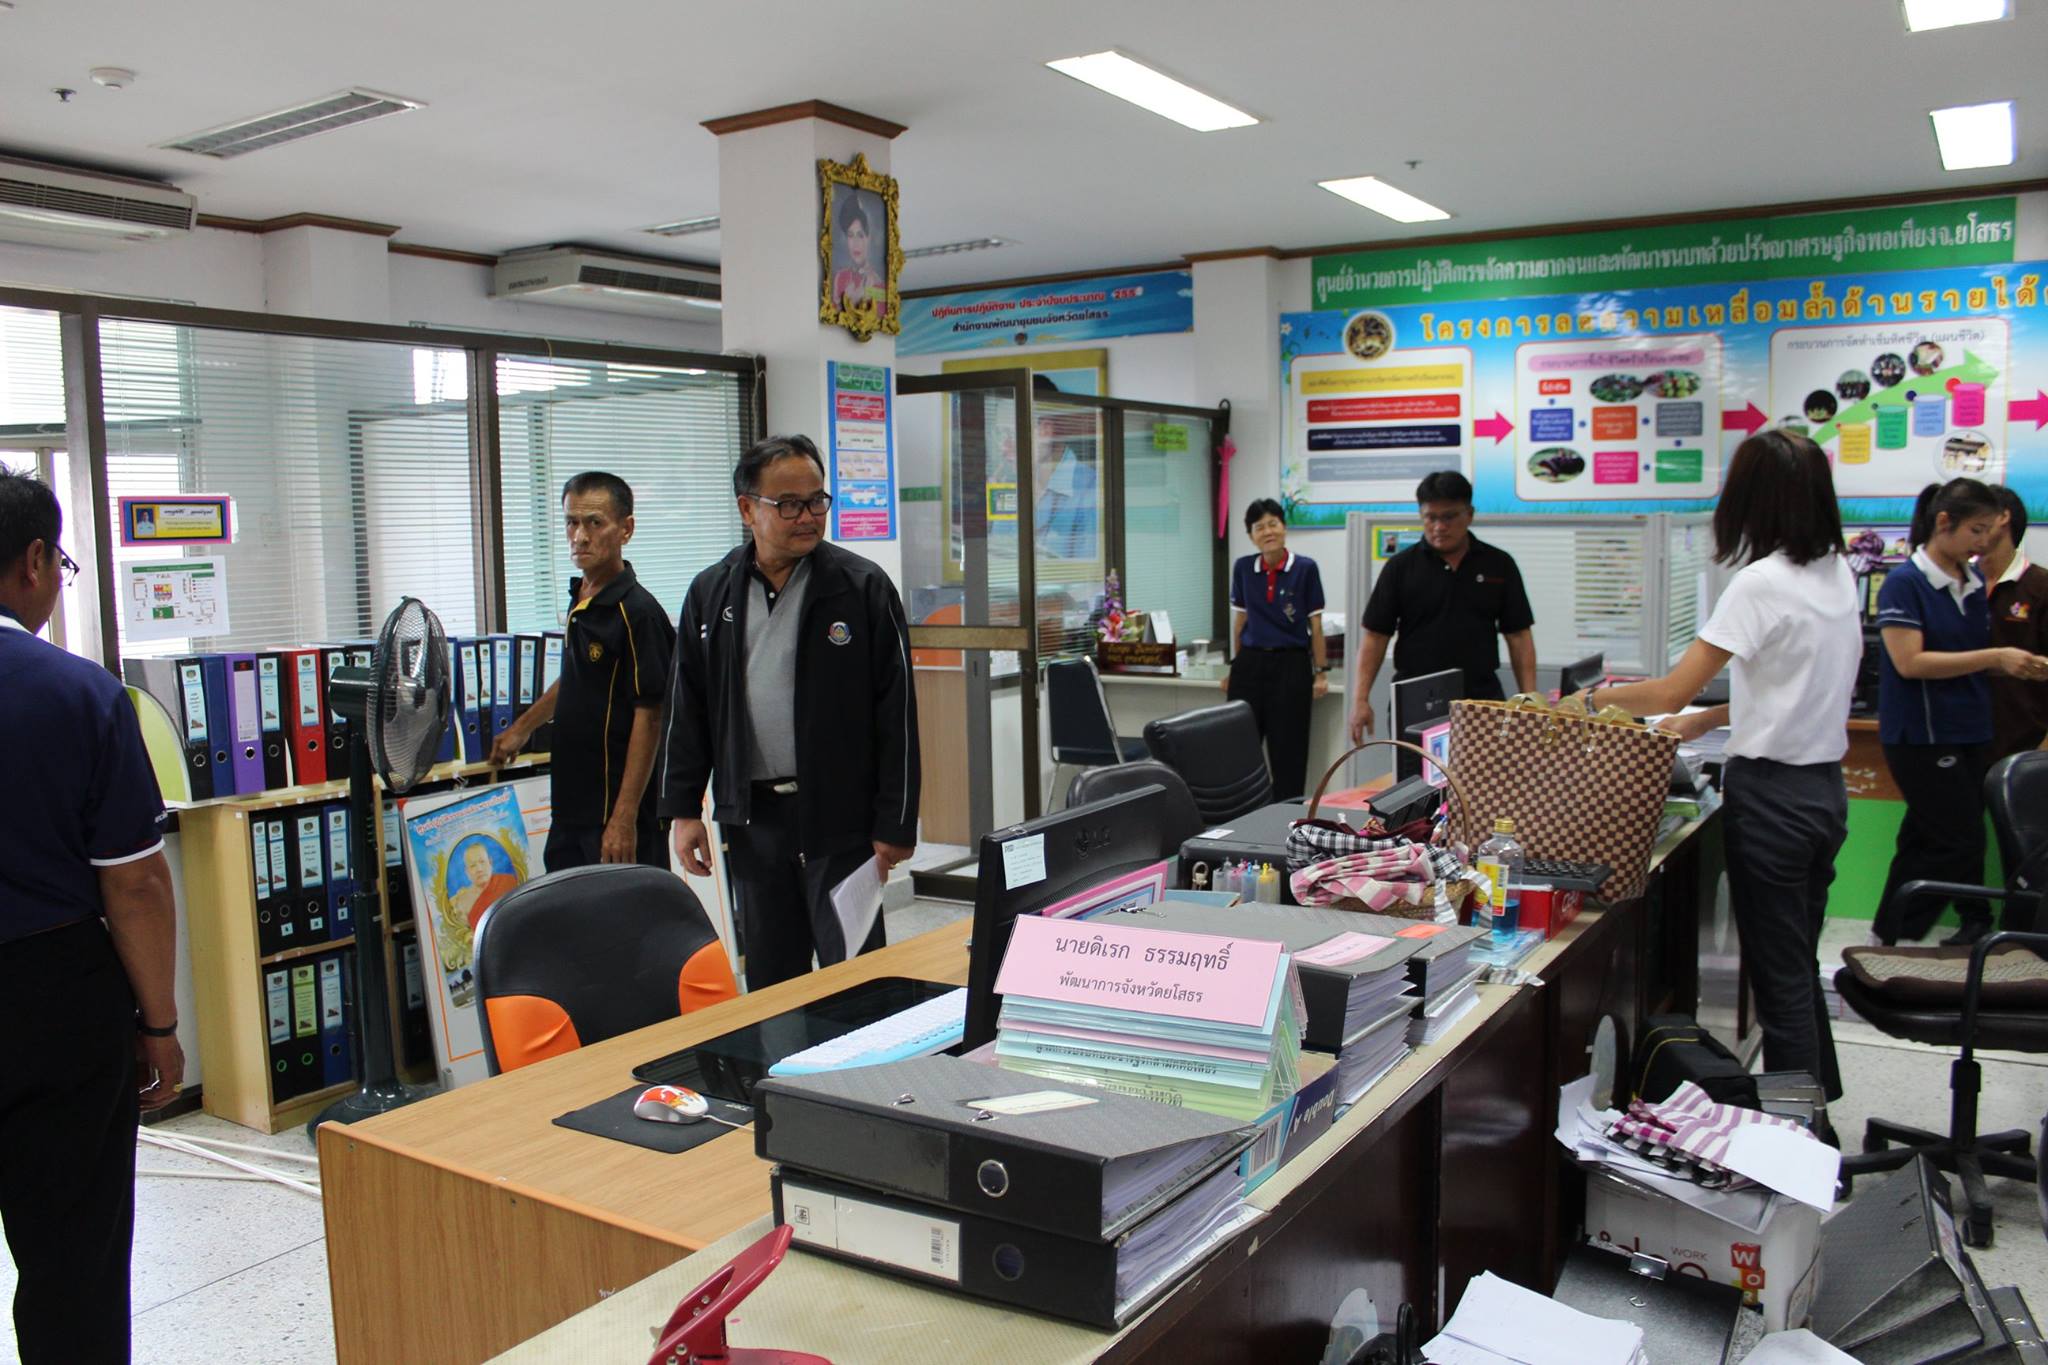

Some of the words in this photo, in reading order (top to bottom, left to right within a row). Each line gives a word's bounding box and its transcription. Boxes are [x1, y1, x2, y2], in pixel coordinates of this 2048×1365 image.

[1113, 286, 1144, 300] 255
[1420, 274, 2048, 342] โครงการลดความเหลื่อมล้ำด้านรายได้
[1056, 934, 1130, 960] นายดิเรก
[1144, 942, 1234, 972] ธรรมฤทธิ์
[1059, 971, 1203, 1004] พัฒนาการจังหวัดยโสธร
[1671, 1246, 1709, 1261] WORK
